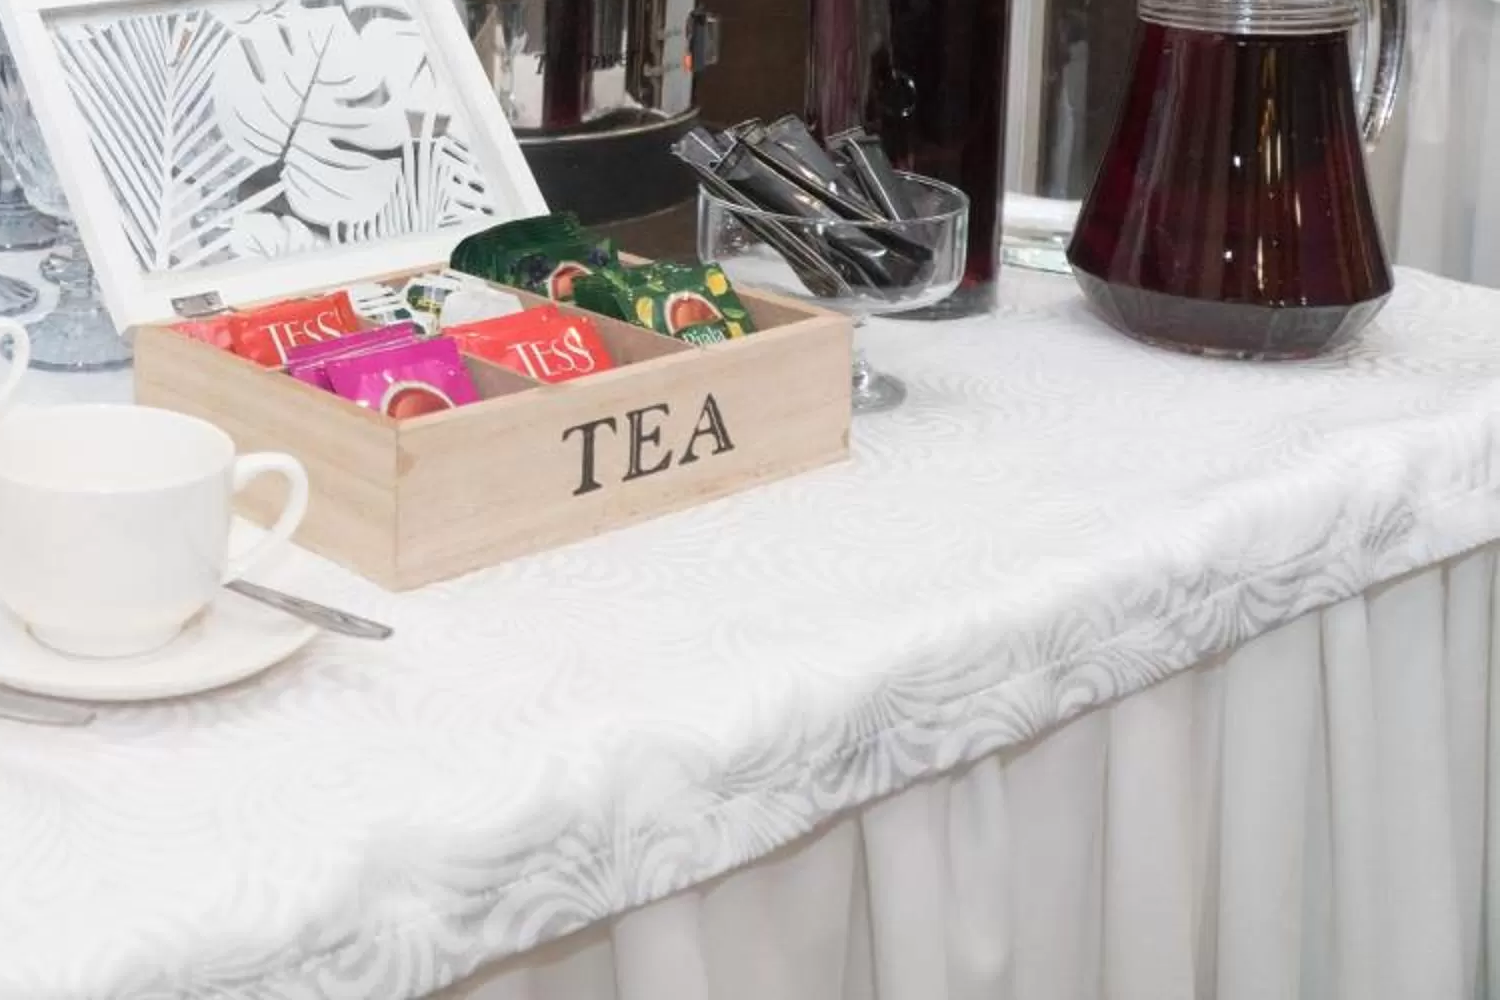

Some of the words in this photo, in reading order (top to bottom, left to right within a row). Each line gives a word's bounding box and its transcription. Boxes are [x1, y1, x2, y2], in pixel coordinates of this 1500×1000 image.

[258, 307, 342, 365] TESS
[506, 326, 595, 379] TESS
[561, 393, 736, 497] TEA
